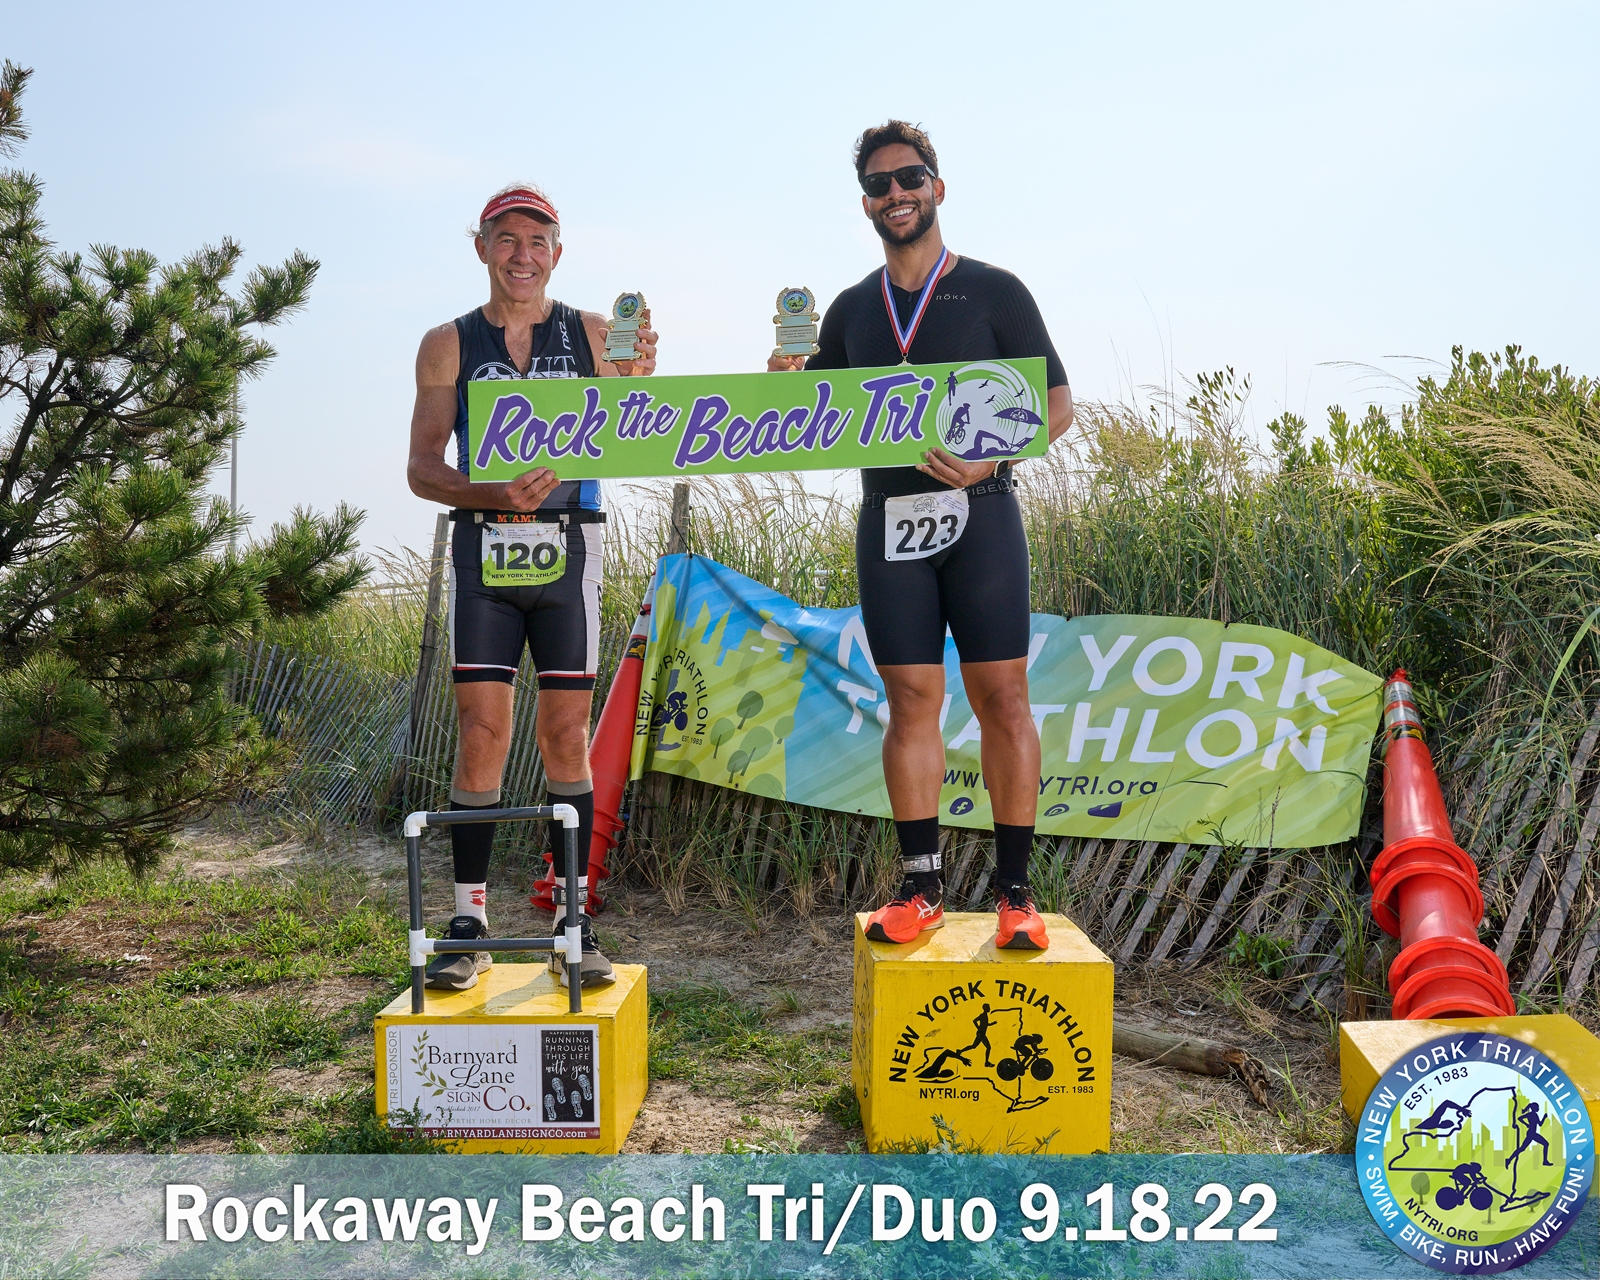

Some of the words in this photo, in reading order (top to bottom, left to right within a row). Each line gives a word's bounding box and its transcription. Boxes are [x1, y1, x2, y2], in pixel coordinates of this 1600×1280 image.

[476, 386, 606, 469] Rock
[617, 390, 683, 441] the
[674, 381, 853, 470] Beach
[858, 372, 936, 448] Tri
[896, 514, 959, 554] 223
[490, 542, 559, 571] 120
[1079, 634, 1346, 717] YORK
[636, 690, 653, 736] NEW
[651, 654, 673, 682] YOR
[675, 648, 709, 735] RIATHLON
[837, 680, 1327, 772] TATHLON
[545, 1036, 589, 1044] RUNNING
[889, 1025, 921, 1083] NEW
[917, 980, 985, 1022] YORK
[995, 979, 1095, 1083] TRIATHLON
[389, 1031, 398, 1085] SPONSOR
[427, 1044, 518, 1067] Barnyard
[546, 1060, 568, 1075] with
[571, 1065, 590, 1080] you
[450, 1064, 515, 1088] Lane
[1048, 1086, 1069, 1094] EST.
[1072, 1086, 1094, 1094] 1983
[447, 1091, 481, 1103] SIGN
[483, 1085, 531, 1112] Co.
[919, 1087, 980, 1102] NYTRI.org
